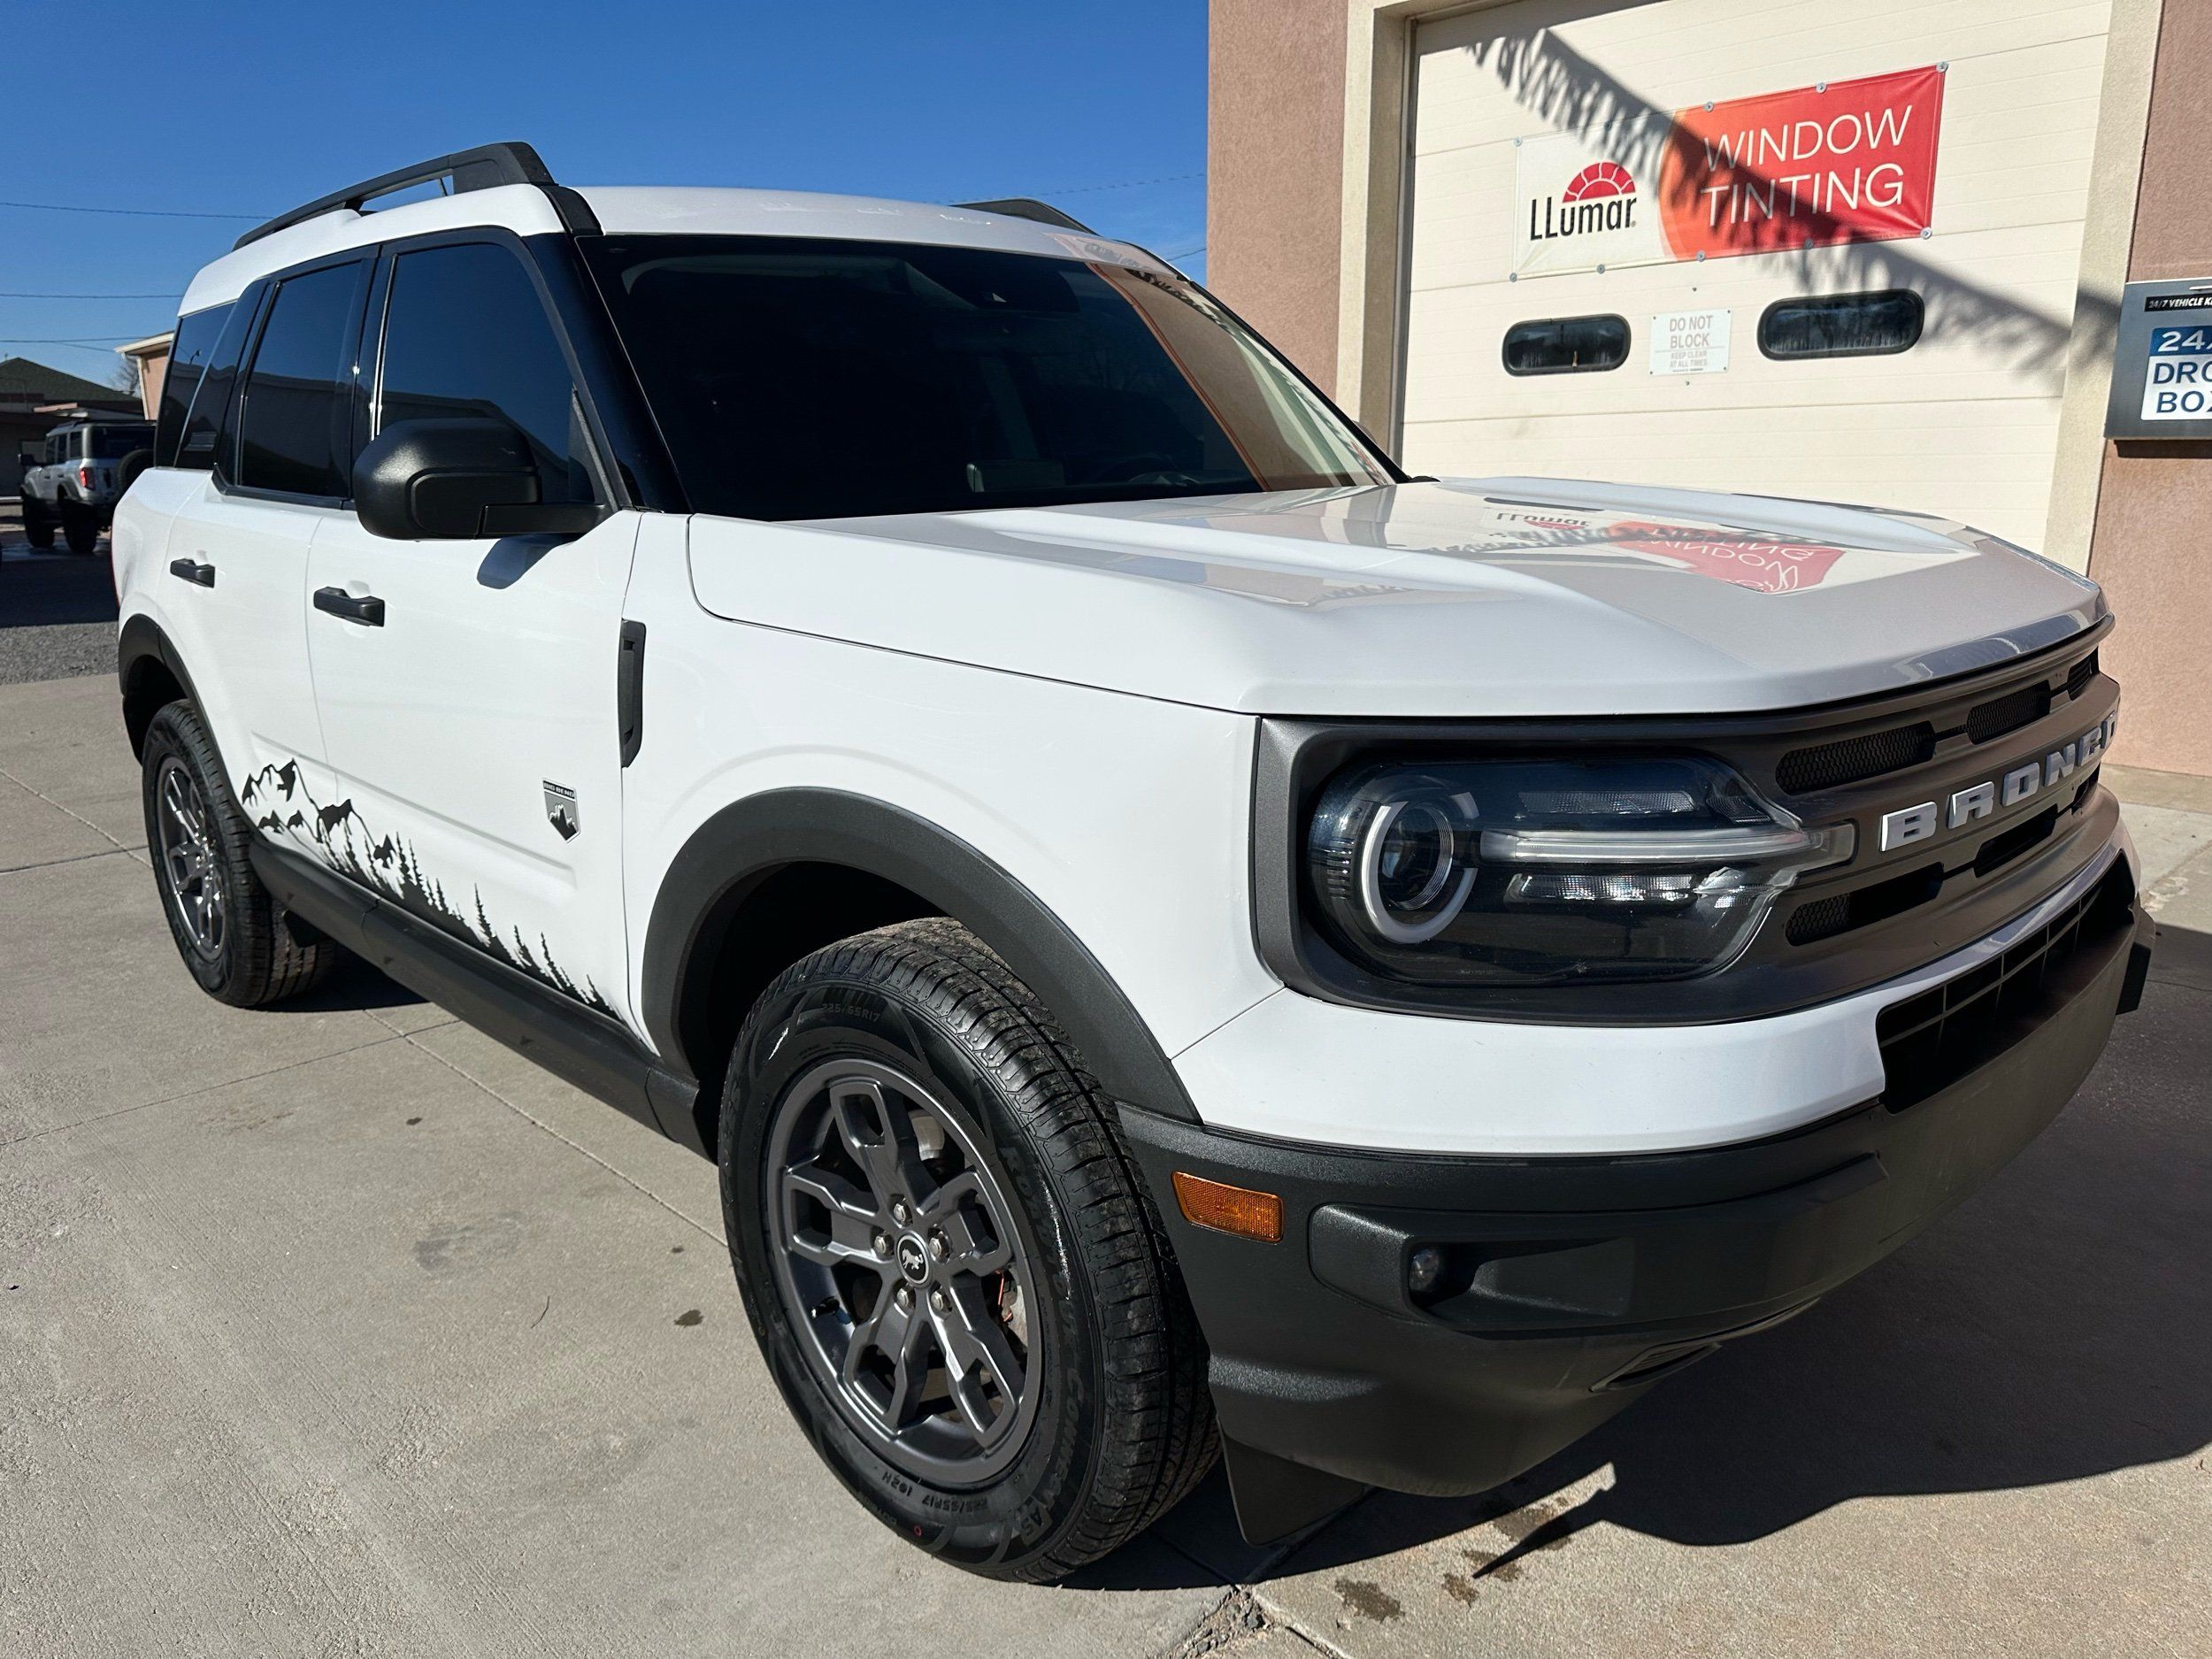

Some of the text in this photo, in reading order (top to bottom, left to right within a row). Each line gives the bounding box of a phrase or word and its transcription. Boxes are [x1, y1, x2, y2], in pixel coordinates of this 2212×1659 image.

[1703, 105, 1914, 173] WINDOW
[1701, 163, 1905, 227] TINTING
[1530, 196, 1637, 241] LLumar
[2169, 297, 2203, 308] VEHICLE
[1670, 315, 1714, 332] DO NOT
[1671, 333, 1710, 349] BLOCK
[2156, 390, 2212, 413] BO
